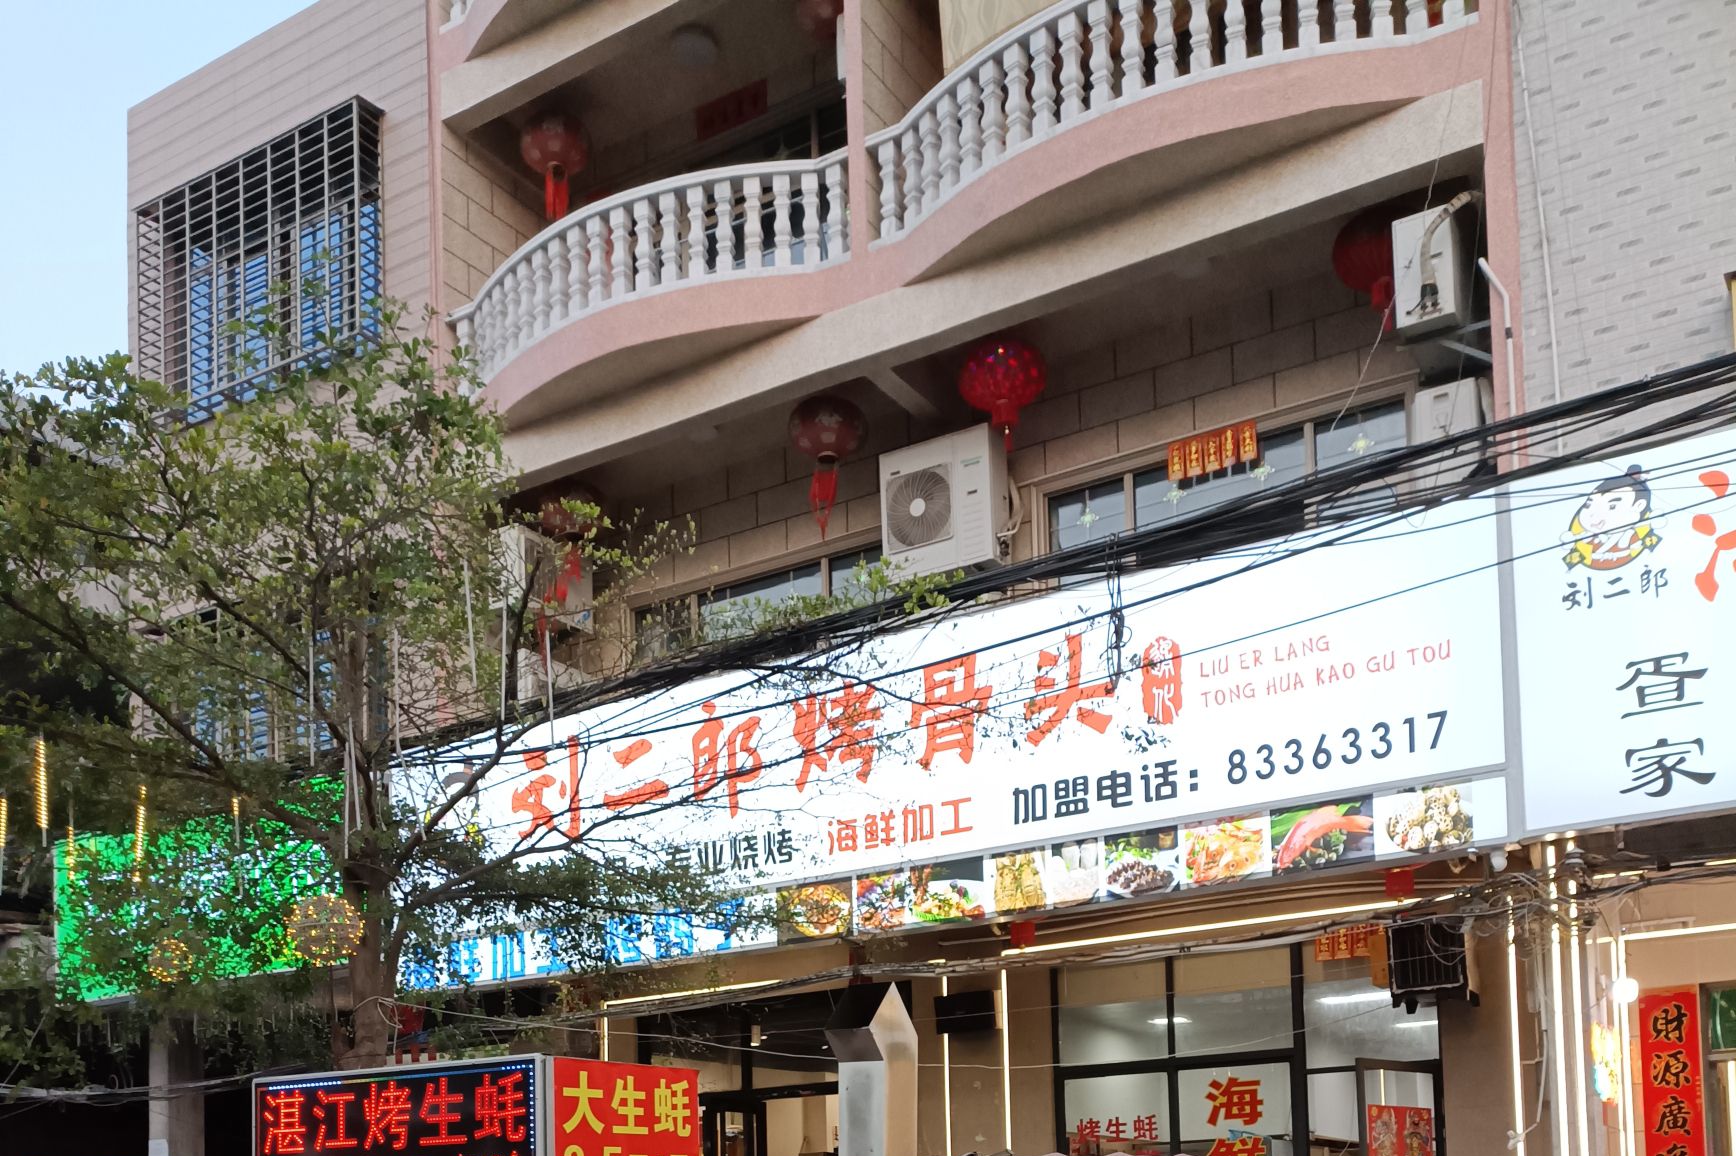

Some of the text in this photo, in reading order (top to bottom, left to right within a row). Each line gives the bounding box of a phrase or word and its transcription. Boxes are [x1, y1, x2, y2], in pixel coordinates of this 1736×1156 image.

[1562, 565, 1668, 610] 刘二郎
[1200, 635, 1331, 678] LIU ER LANG
[1200, 639, 1452, 709] TONG HUA KAO GU TOU
[511, 633, 1116, 841] 刘二郎烤骨头
[1227, 709, 1448, 786] 83363317
[828, 797, 973, 856] 海鲜加工
[264, 1070, 526, 1155] 湛江烤生蚝
[562, 1070, 692, 1138] 大生蚝
[1076, 1114, 1159, 1145] 烤生蚝
